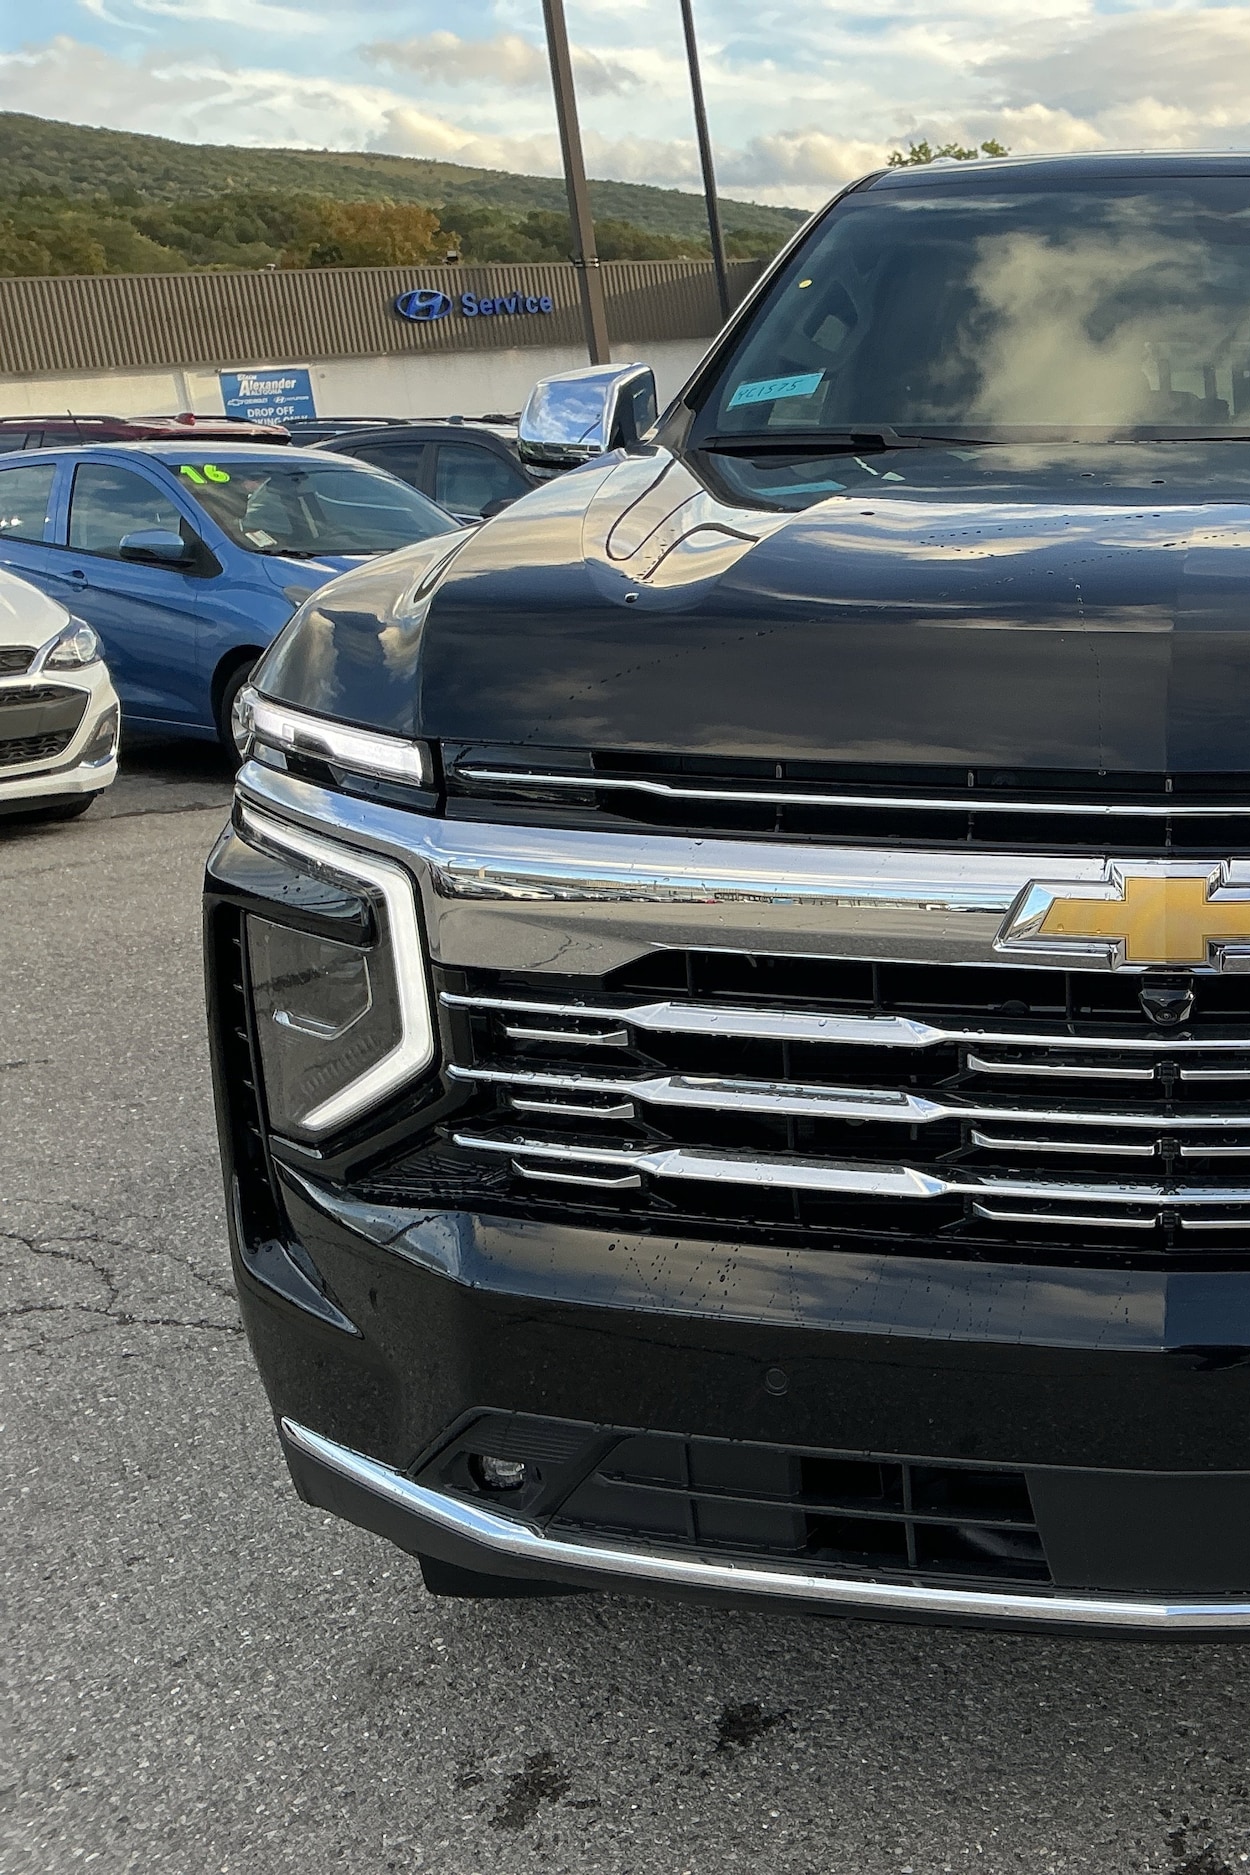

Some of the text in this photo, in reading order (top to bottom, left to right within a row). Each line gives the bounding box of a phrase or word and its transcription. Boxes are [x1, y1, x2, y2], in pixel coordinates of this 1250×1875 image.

[461, 290, 553, 317] Service
[239, 378, 296, 396] Alexander
[247, 407, 273, 418] DROP
[276, 406, 294, 416] OFF
[180, 464, 230, 484] 16
